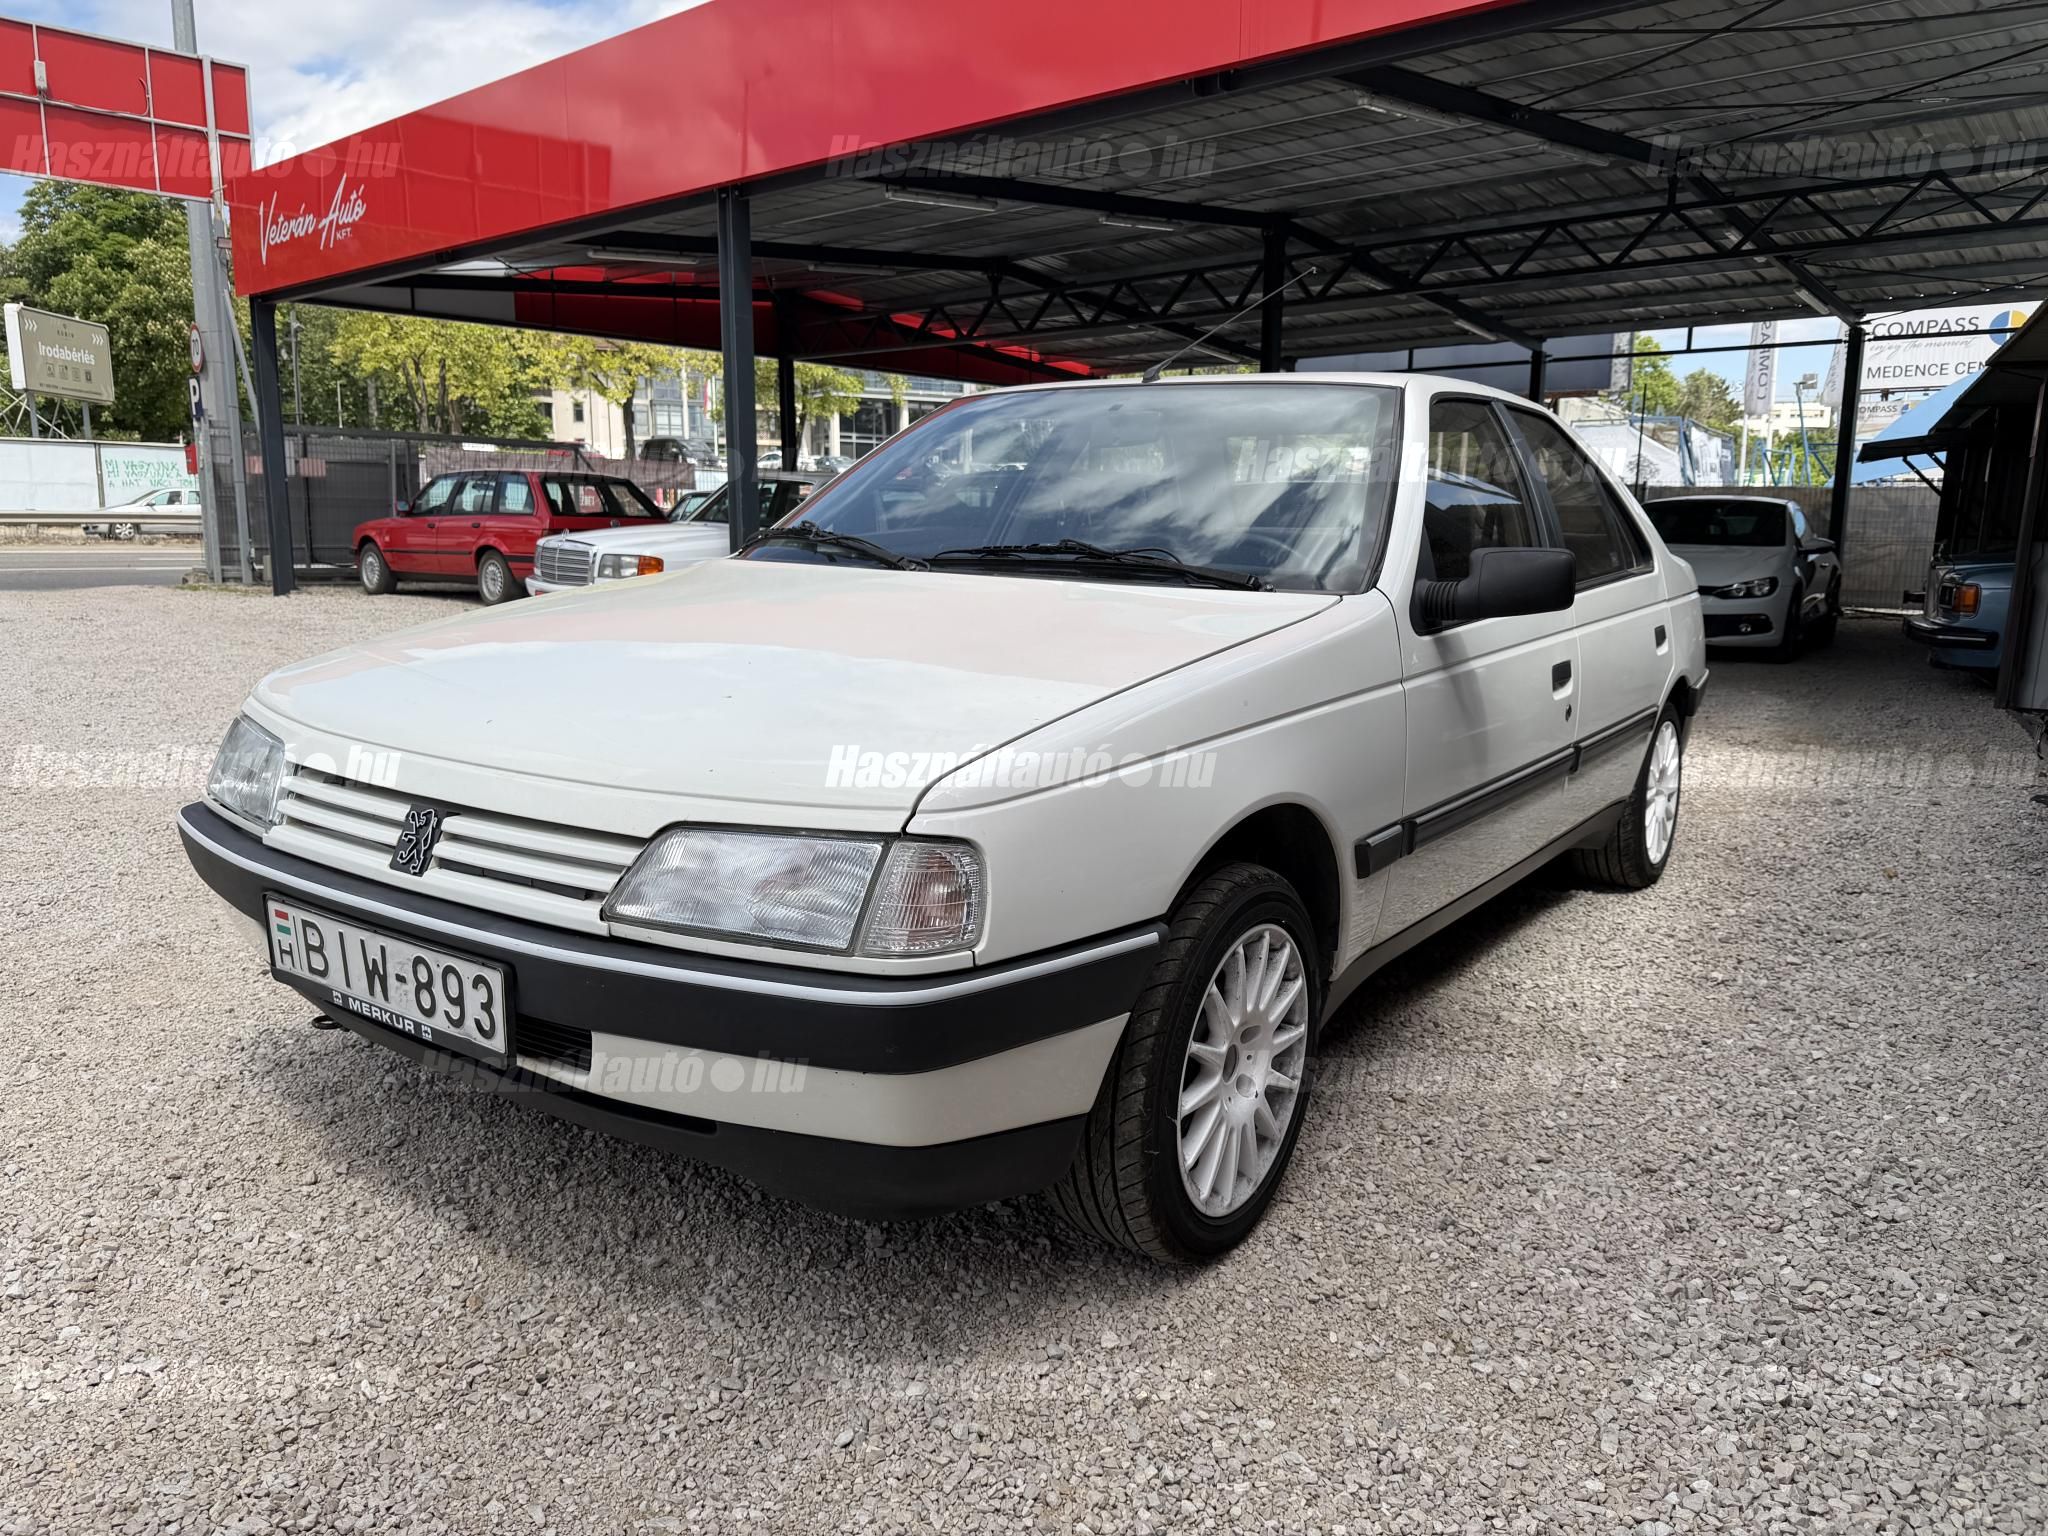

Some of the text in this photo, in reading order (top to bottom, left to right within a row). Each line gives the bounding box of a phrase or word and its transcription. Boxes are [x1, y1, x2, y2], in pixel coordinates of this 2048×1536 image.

[259, 172, 366, 266] Veterán Autó
[336, 227, 353, 240] KFT.
[1872, 316, 1979, 337] COMPASS
[38, 341, 95, 366] Irodabérlés
[1866, 363, 1950, 380] MEDENCE
[190, 377, 200, 416] P
[1856, 405, 1898, 414] OMPASS
[278, 917, 496, 1040] H BIW-893
[348, 996, 415, 1034] MERKUR
